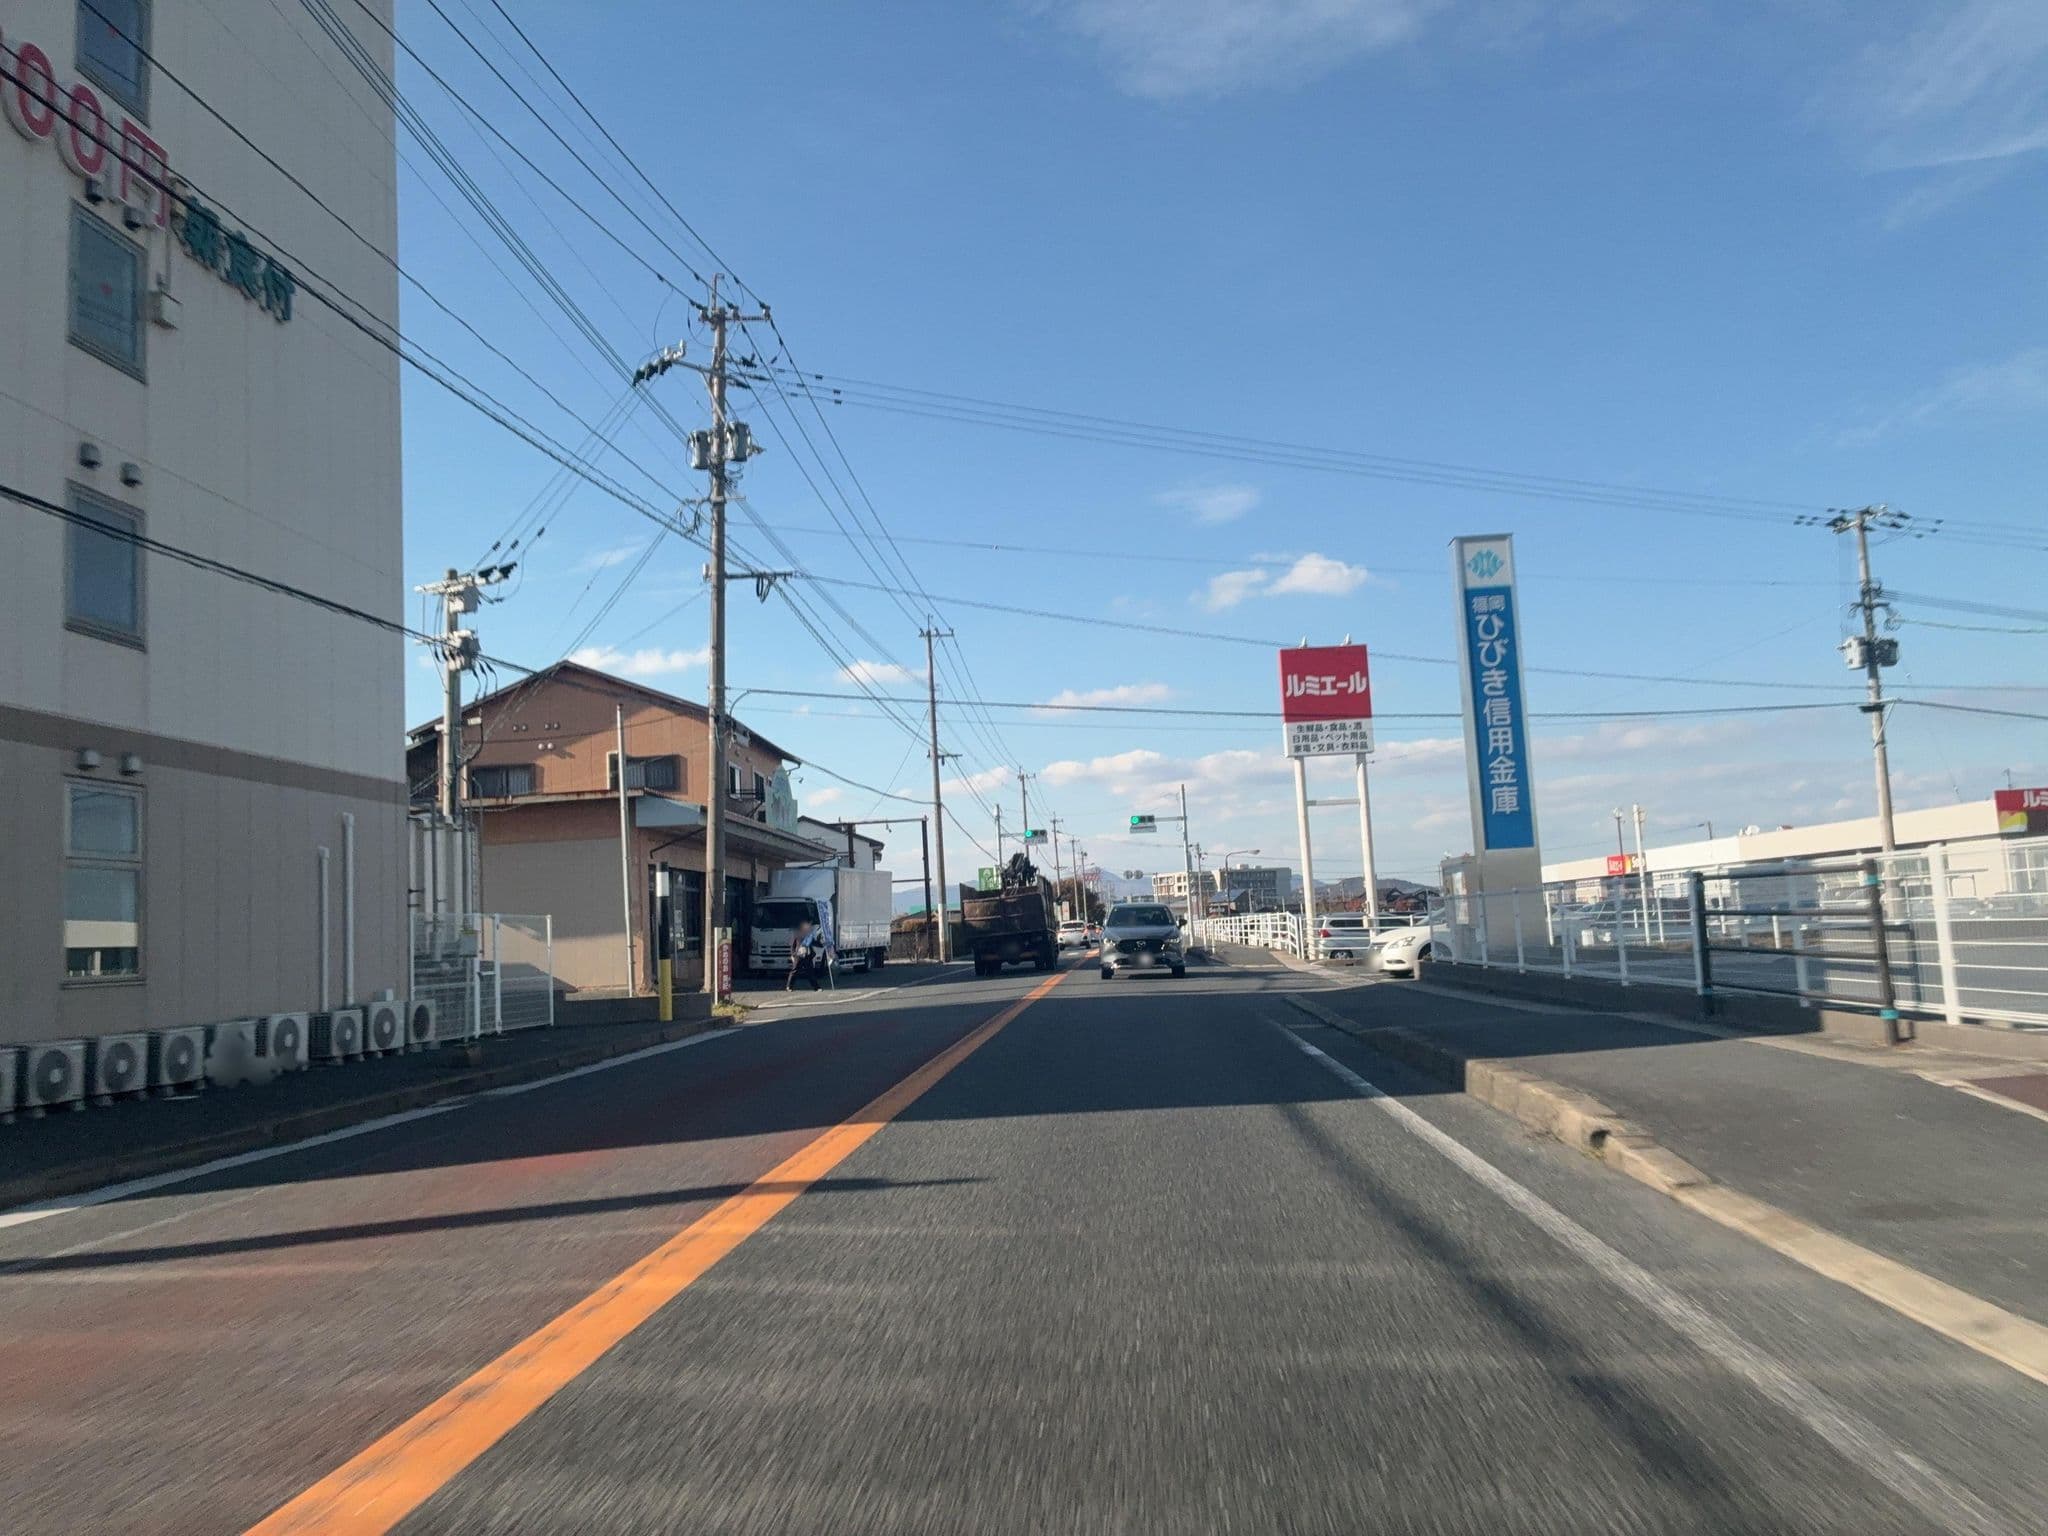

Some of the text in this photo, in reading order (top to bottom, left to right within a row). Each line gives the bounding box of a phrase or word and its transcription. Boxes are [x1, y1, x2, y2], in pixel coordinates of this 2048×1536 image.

[0, 26, 169, 228] 00円
[1286, 672, 1366, 697] ルミエール
[1476, 614, 1520, 815] ひびき信用金庫
